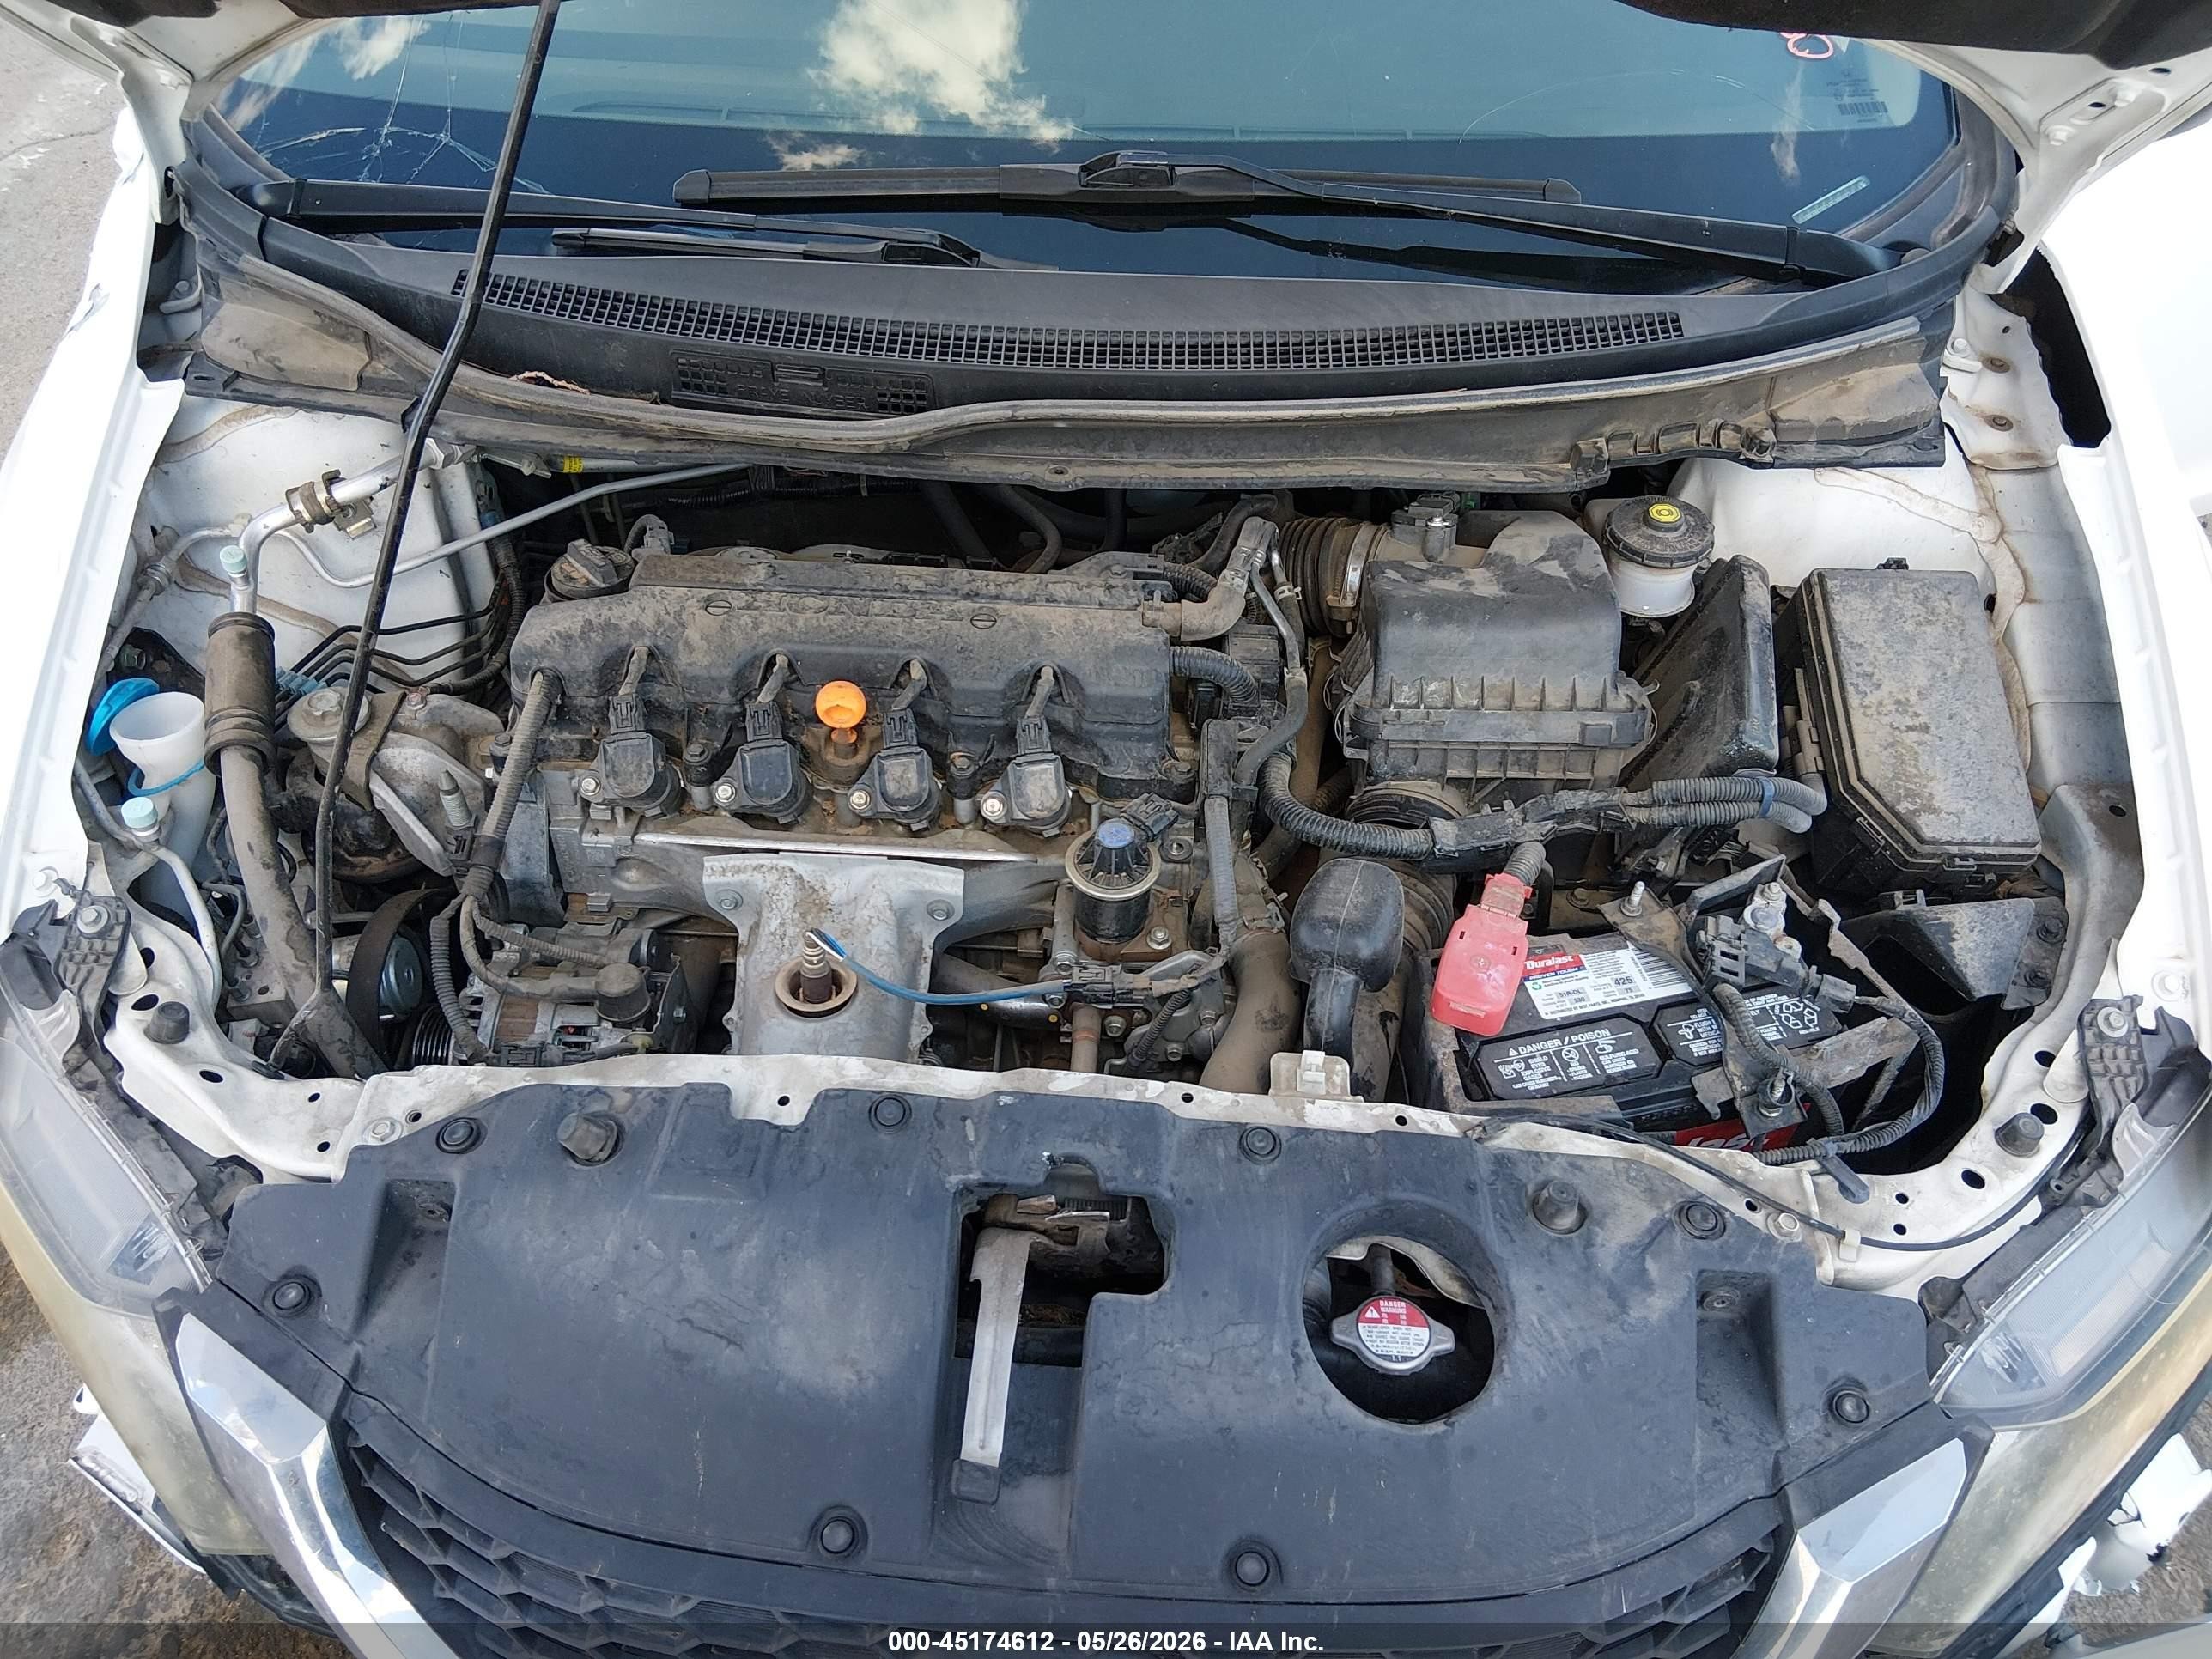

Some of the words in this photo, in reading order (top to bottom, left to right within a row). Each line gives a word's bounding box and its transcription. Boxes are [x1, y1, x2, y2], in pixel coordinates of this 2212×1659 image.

[802, 390, 868, 412] NUMBER
[1524, 955, 1574, 970] Duralast
[1528, 971, 1556, 981] PROVEN
[1556, 967, 1579, 975] TOUGH
[1614, 975, 1633, 986] 425
[1517, 1038, 1563, 1054] DANGER
[1571, 1029, 1612, 1043] POISON
